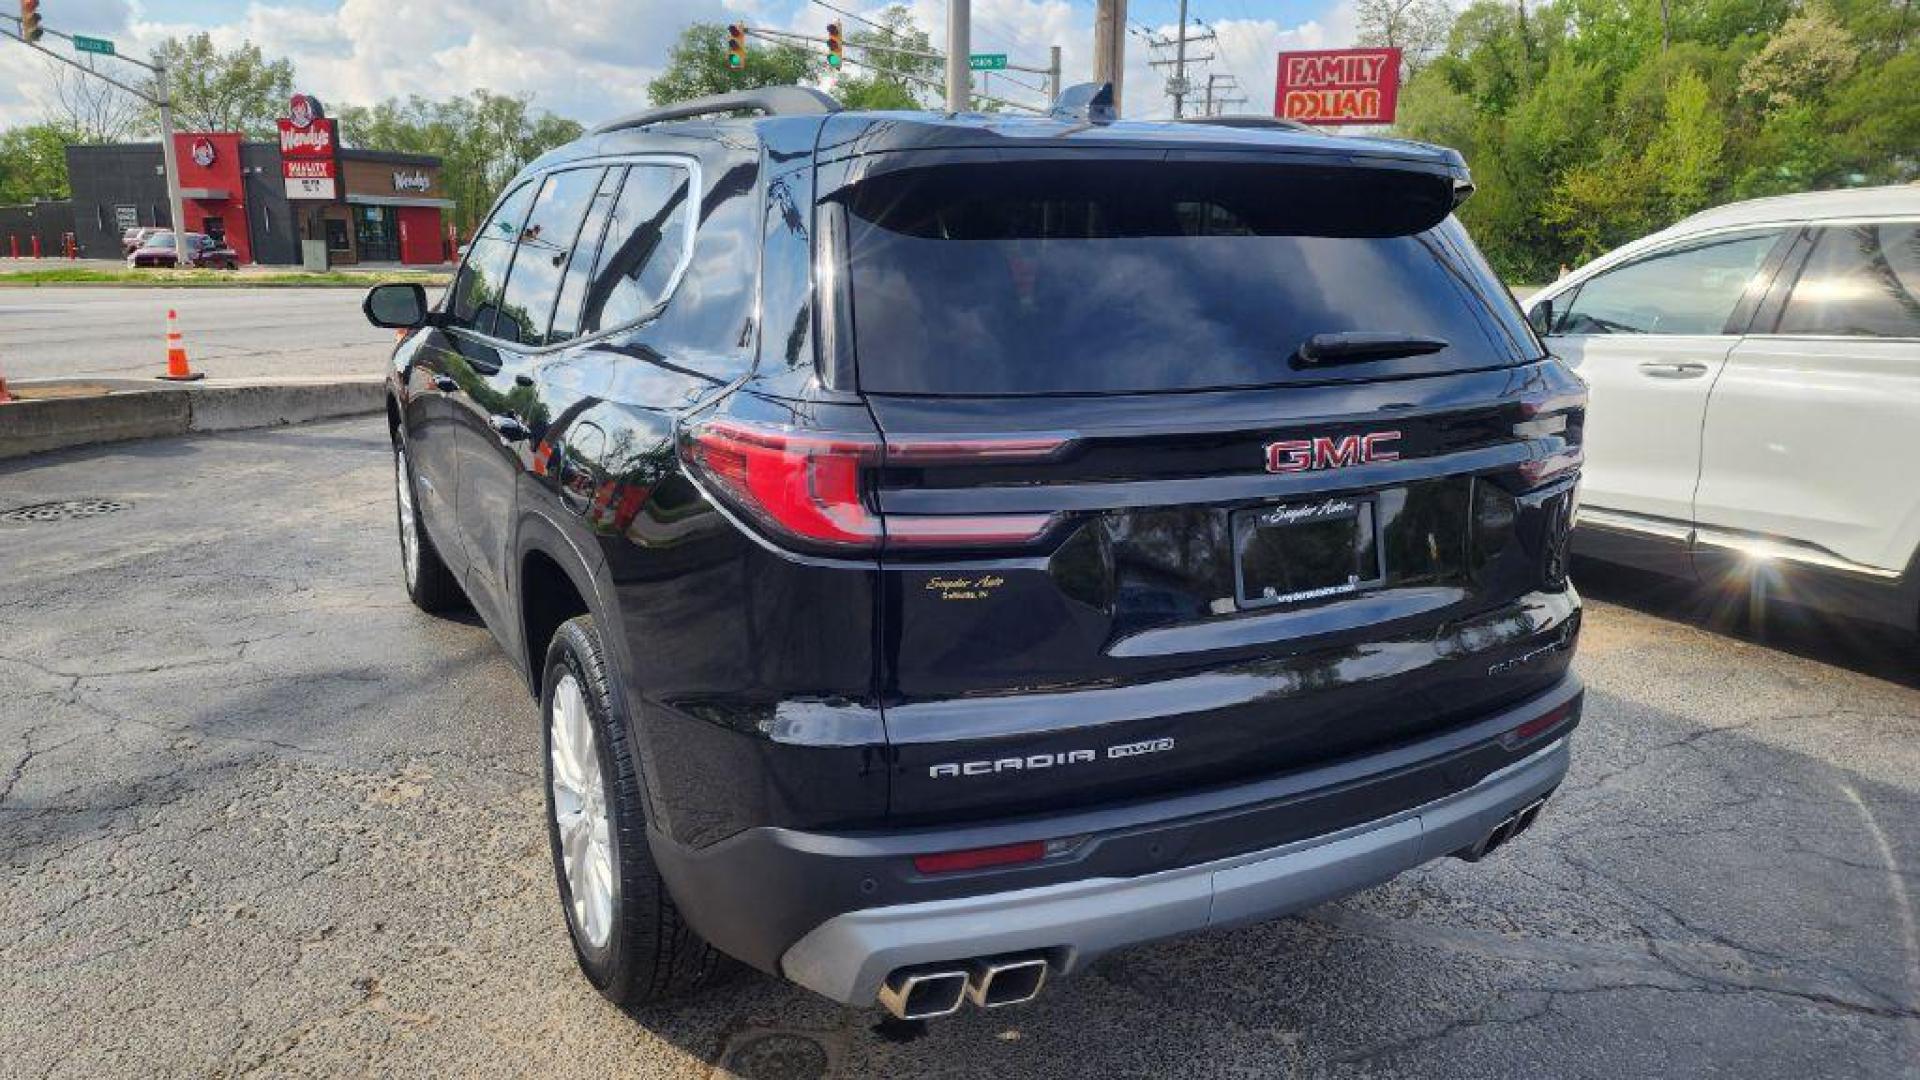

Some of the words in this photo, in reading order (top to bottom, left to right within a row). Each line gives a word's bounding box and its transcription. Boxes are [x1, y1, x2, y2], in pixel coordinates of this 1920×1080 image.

[1287, 54, 1388, 87] FAMILY
[1285, 88, 1381, 119] DOLLAR
[1265, 431, 1402, 473] GMC
[929, 748, 1096, 779] ACADIA
[1107, 737, 1175, 759] AWD
